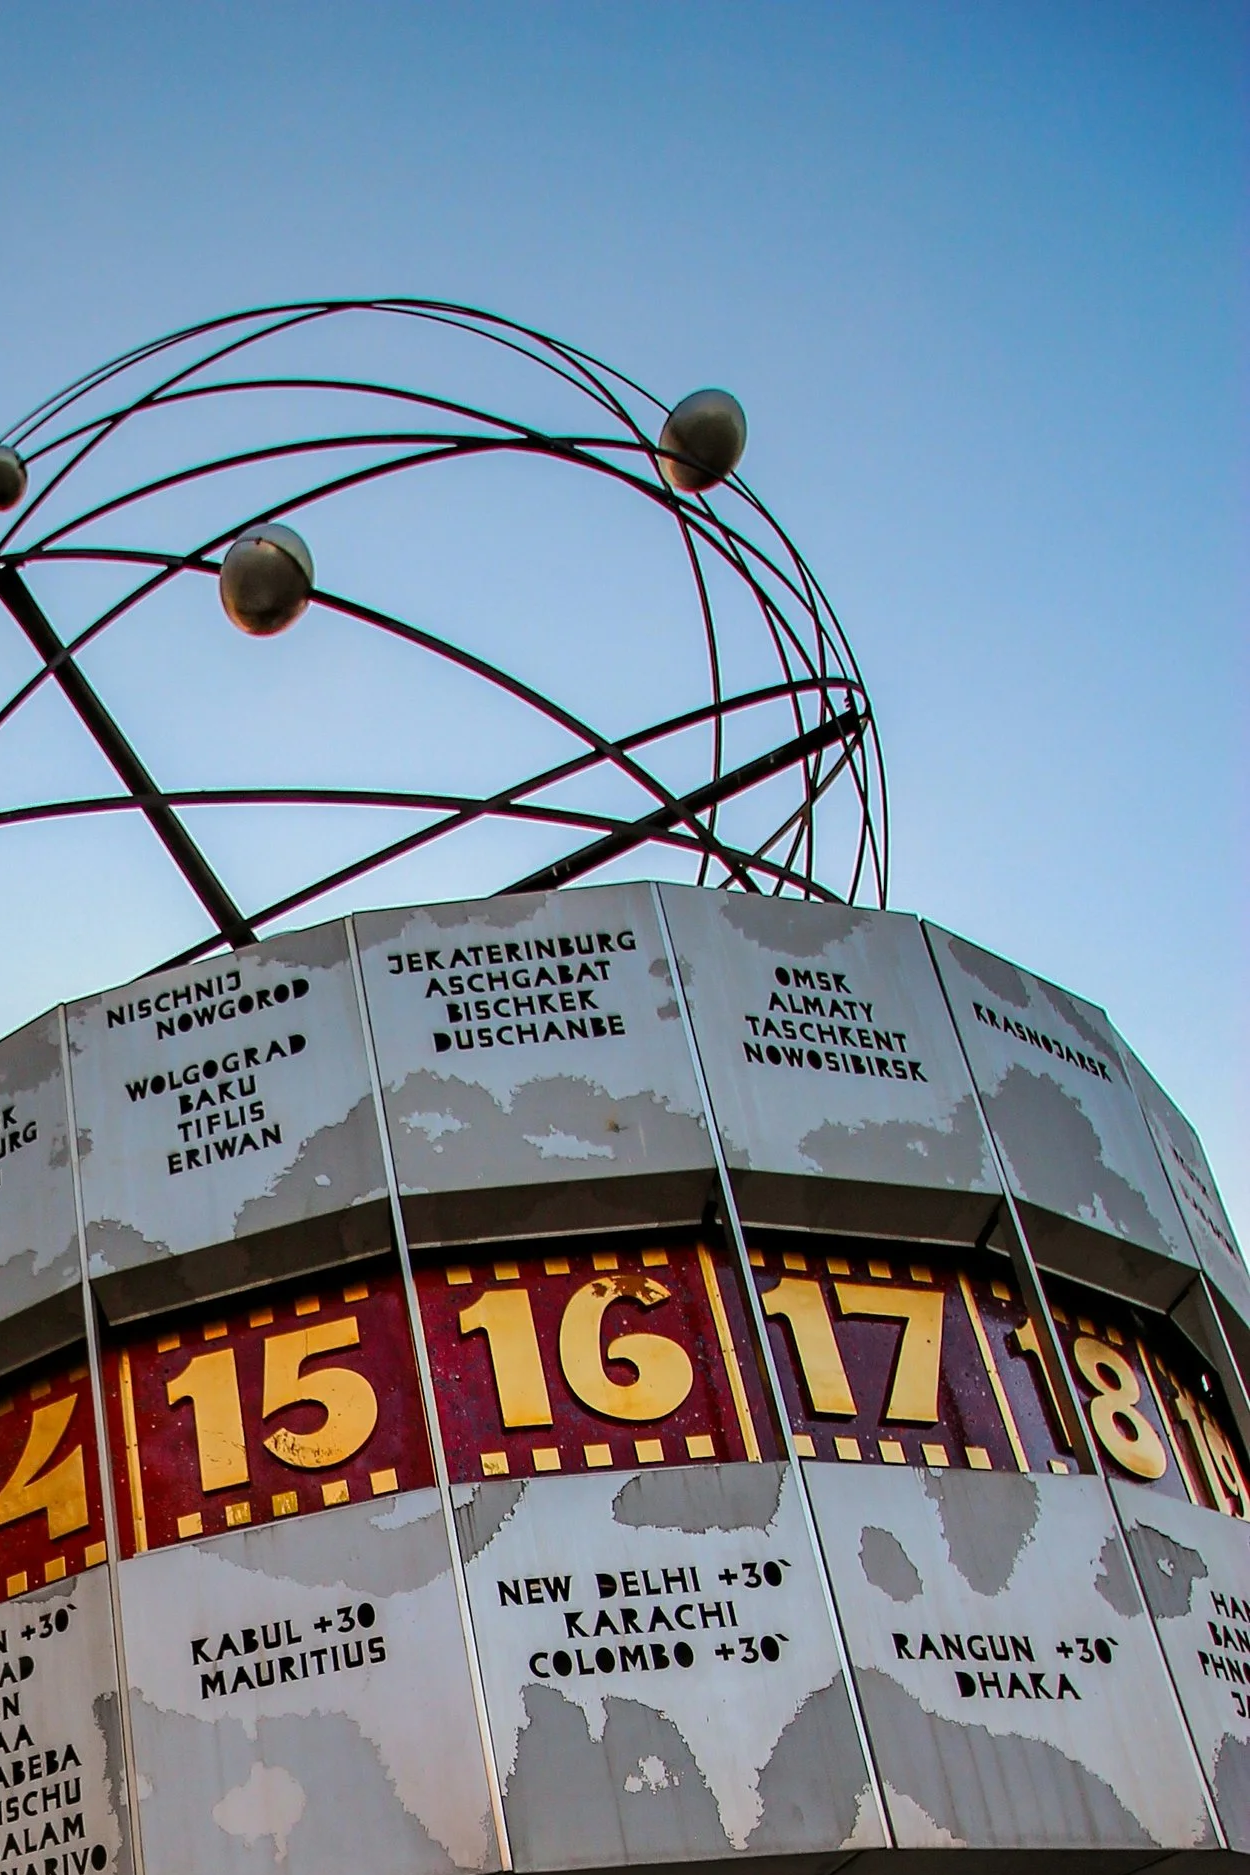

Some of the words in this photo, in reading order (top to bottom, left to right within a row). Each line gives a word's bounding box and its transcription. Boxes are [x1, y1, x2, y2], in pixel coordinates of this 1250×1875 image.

[387, 931, 637, 975] JEKATERINBURG
[106, 970, 241, 1029] NISCHNIJ
[424, 961, 612, 999] ASCHGABAT
[774, 966, 852, 994] OMSK
[156, 978, 310, 1040] NOWGOROD
[445, 990, 600, 1024] BISCHKEK
[767, 991, 874, 1024] ALMATY
[433, 1015, 626, 1053] DUSCHANBE
[744, 1014, 908, 1054] TASCHKENT
[971, 1001, 1113, 1083] KRASNOJARSK
[125, 1033, 307, 1102] WOLGOGRAD
[741, 1041, 929, 1083] NOWOSIBIRSK
[178, 1075, 257, 1115] BAKU
[177, 1101, 265, 1142] TIFLIS
[167, 1124, 283, 1175] ERIWAN
[459, 1275, 694, 1429] 16
[761, 1278, 946, 1424] 17
[165, 1315, 378, 1493] 15
[1010, 1316, 1168, 1481] 18
[497, 1575, 571, 1607] NEW
[597, 1567, 700, 1598] DELHI
[191, 1619, 302, 1665] KABUL
[313, 1601, 376, 1635] +30
[563, 1600, 738, 1639] KARACHI
[528, 1641, 694, 1678] COLOMBO
[891, 1632, 1035, 1662] RANGUN
[200, 1636, 387, 1700] MAURITIUS
[954, 1671, 1082, 1700] DHAKA
